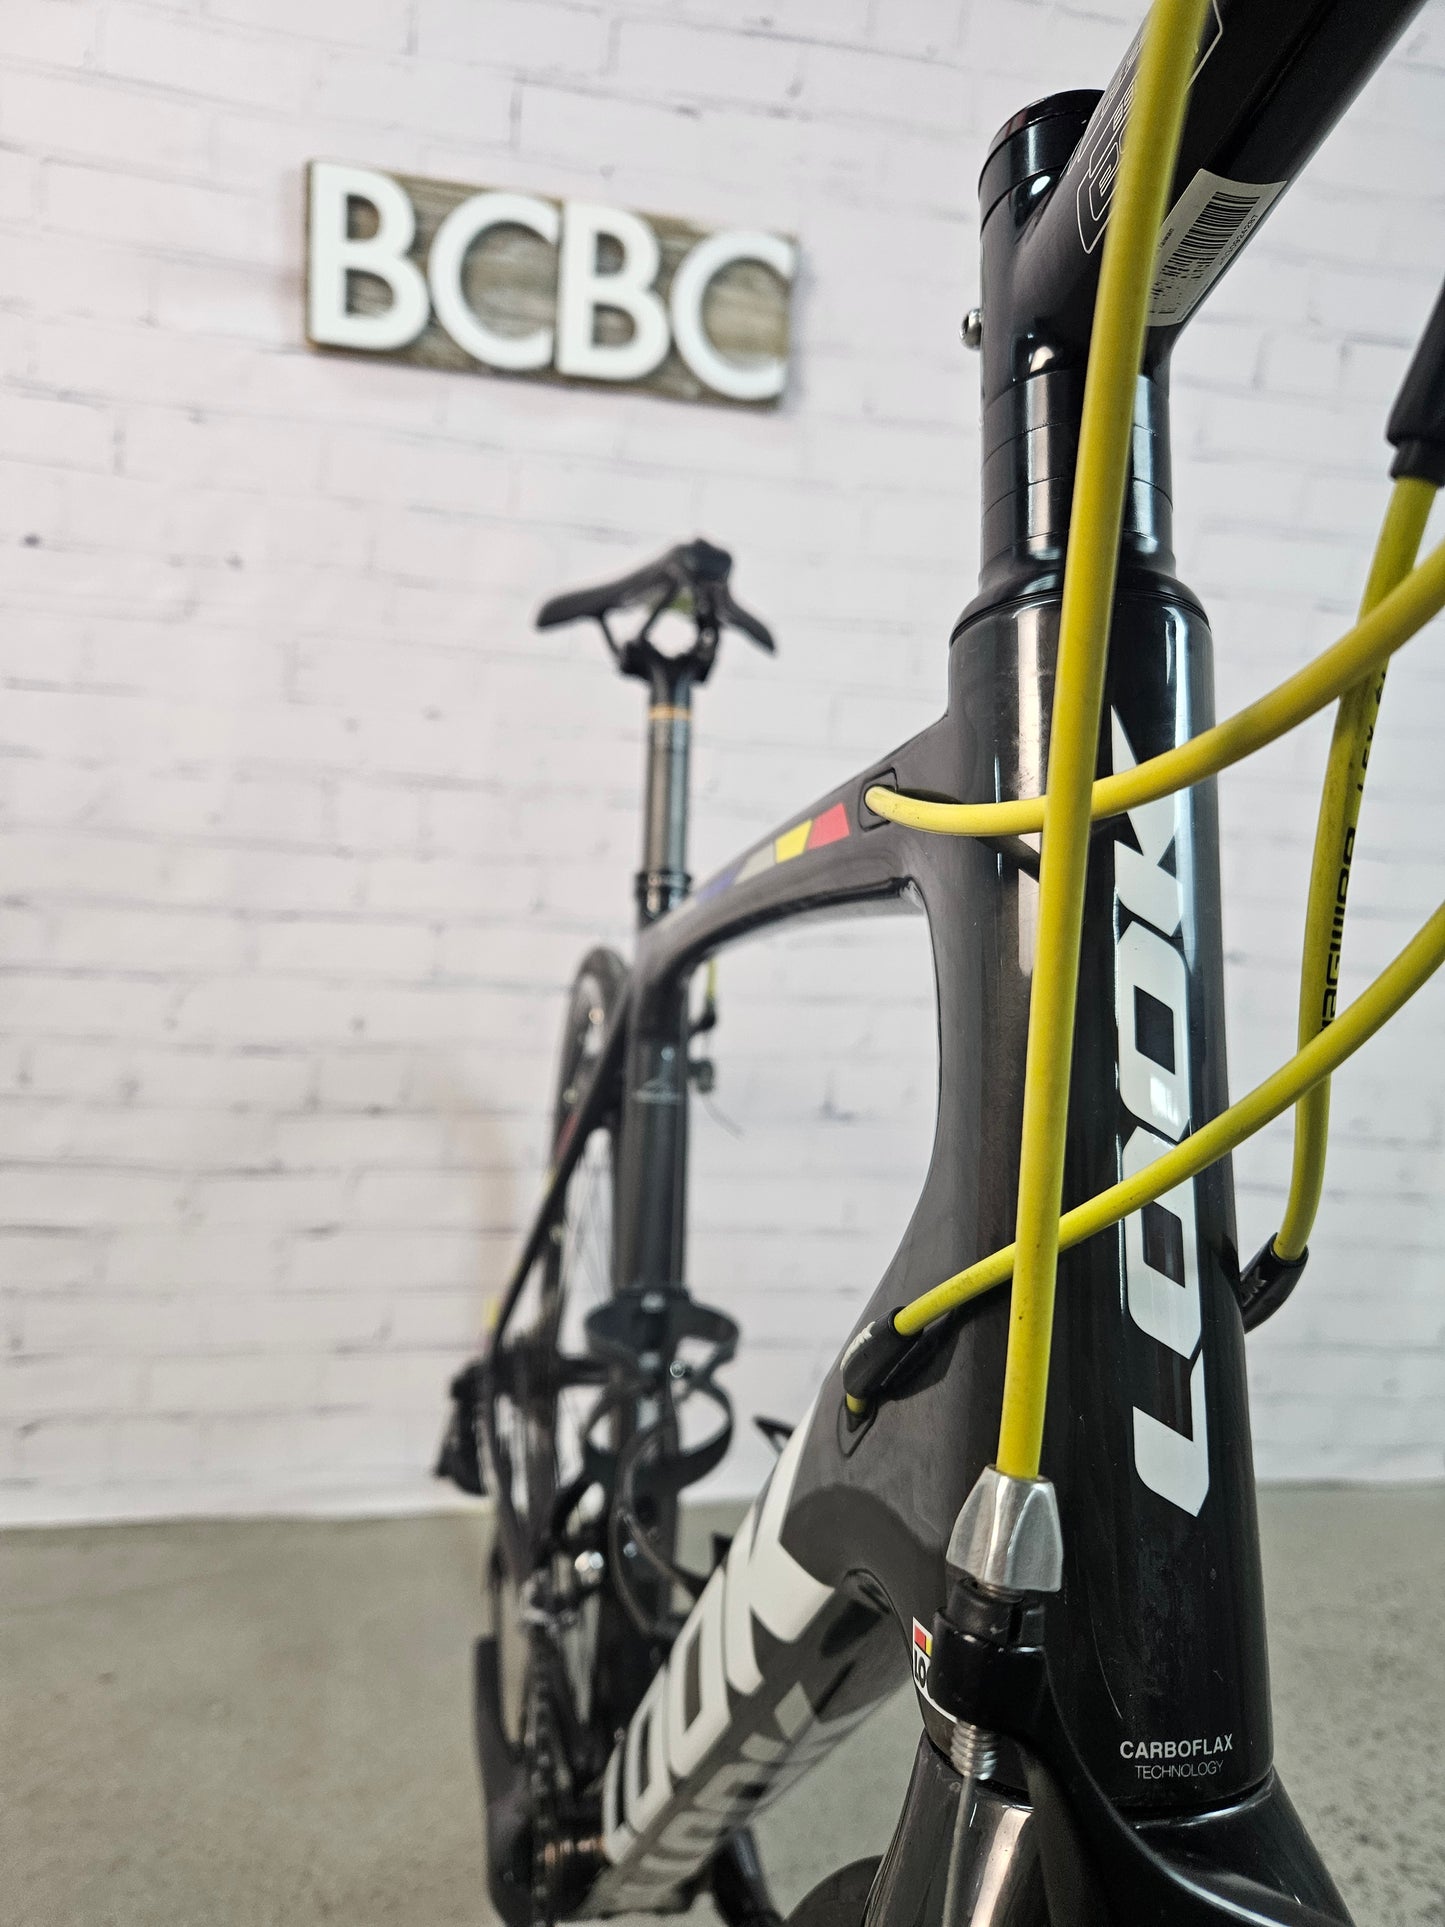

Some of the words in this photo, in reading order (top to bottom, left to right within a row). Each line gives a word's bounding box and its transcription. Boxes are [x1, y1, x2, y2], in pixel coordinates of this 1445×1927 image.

[310, 161, 797, 400] BCBC
[1110, 704, 1211, 1519] LOOK
[1119, 1733, 1234, 1760] CARBOFLAX
[1134, 1759, 1225, 1780] TECHNOLOGY
